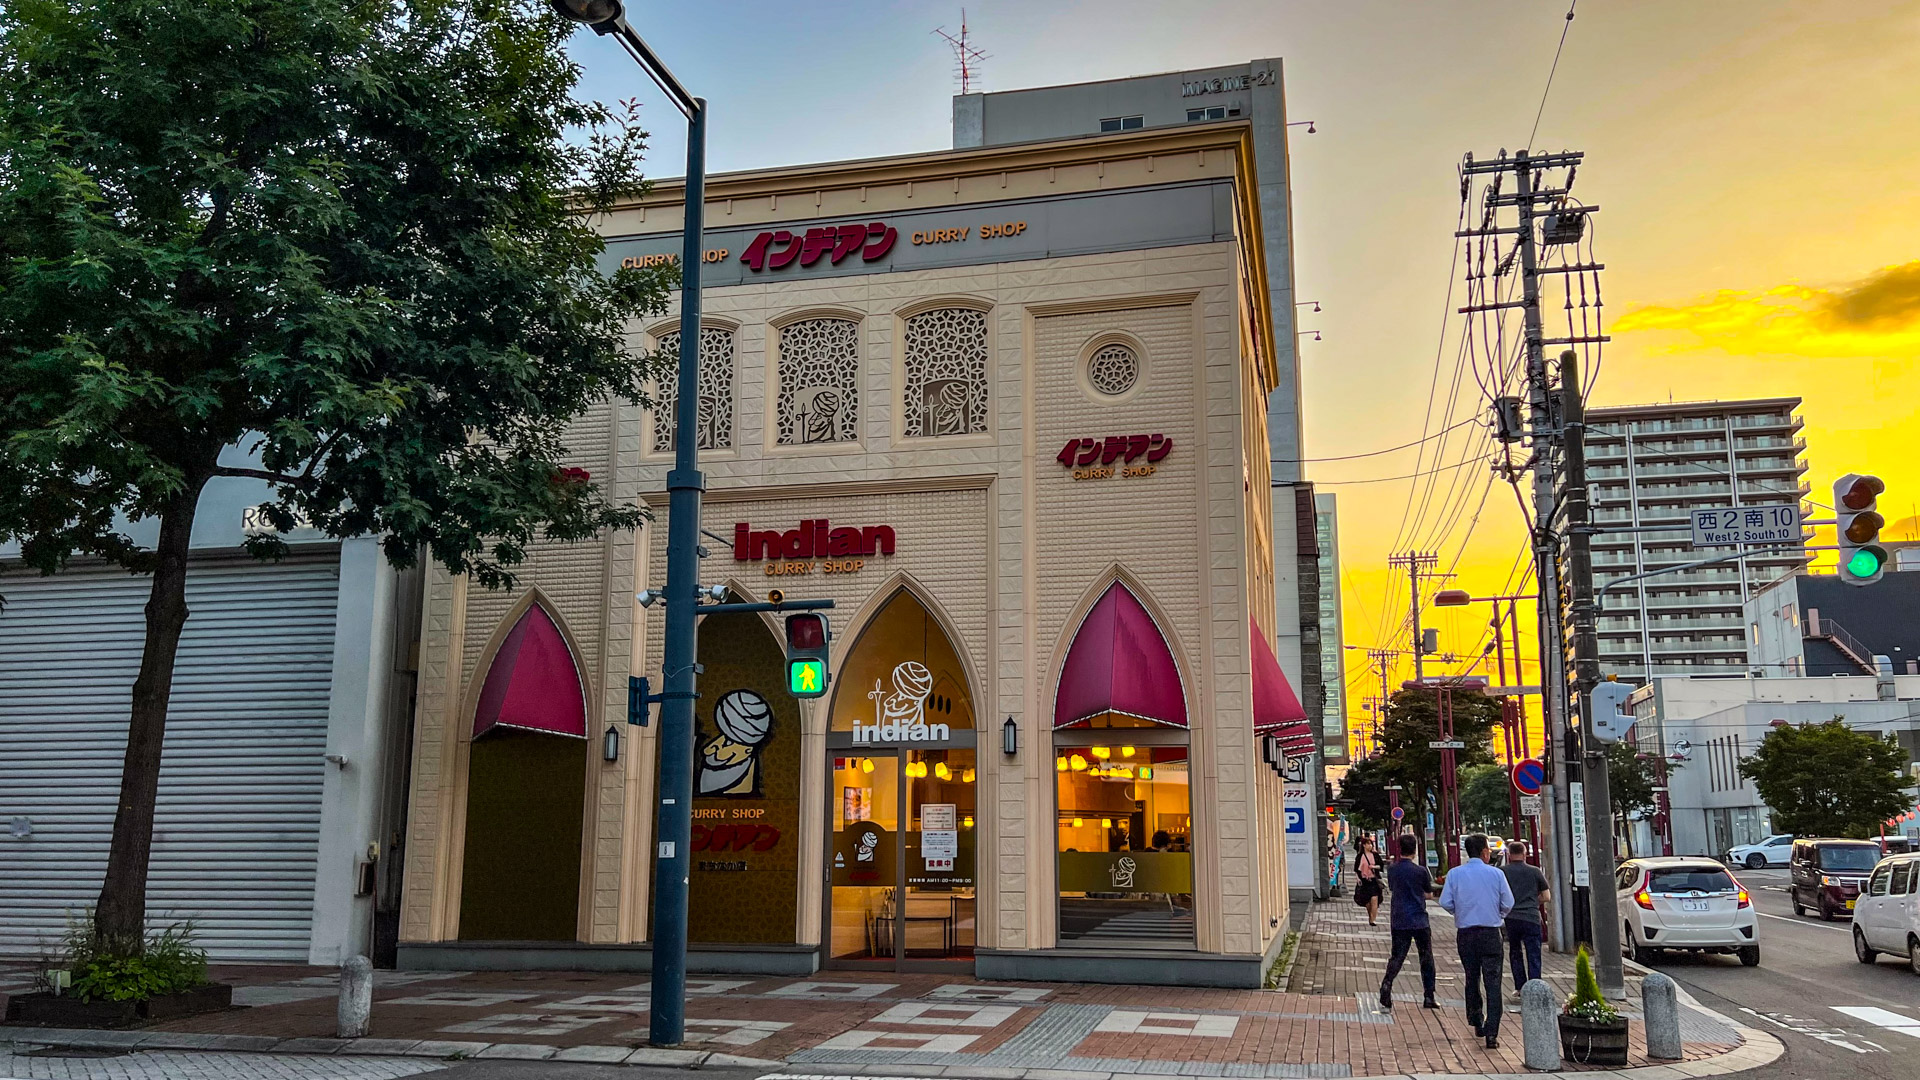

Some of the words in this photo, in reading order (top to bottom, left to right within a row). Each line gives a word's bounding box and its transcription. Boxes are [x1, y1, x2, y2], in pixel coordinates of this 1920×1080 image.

[1182, 70, 1275, 98] IMAGINE-21
[911, 227, 970, 245] CURRY
[980, 221, 1027, 240] SHOP
[740, 222, 898, 272] インデアン
[622, 253, 676, 269] CURRY
[1057, 433, 1172, 467] インデアン
[1073, 468, 1115, 480] CURRY
[1122, 465, 1156, 477] SHOP
[734, 519, 896, 560] indian
[1704, 532, 1731, 542] West
[1733, 532, 1740, 541] 2
[1744, 530, 1775, 541] South
[1777, 529, 1789, 538] 10
[764, 561, 815, 576] CURRY
[823, 559, 865, 573] SHOP
[853, 719, 949, 742] indian
[732, 809, 765, 819] SHOP
